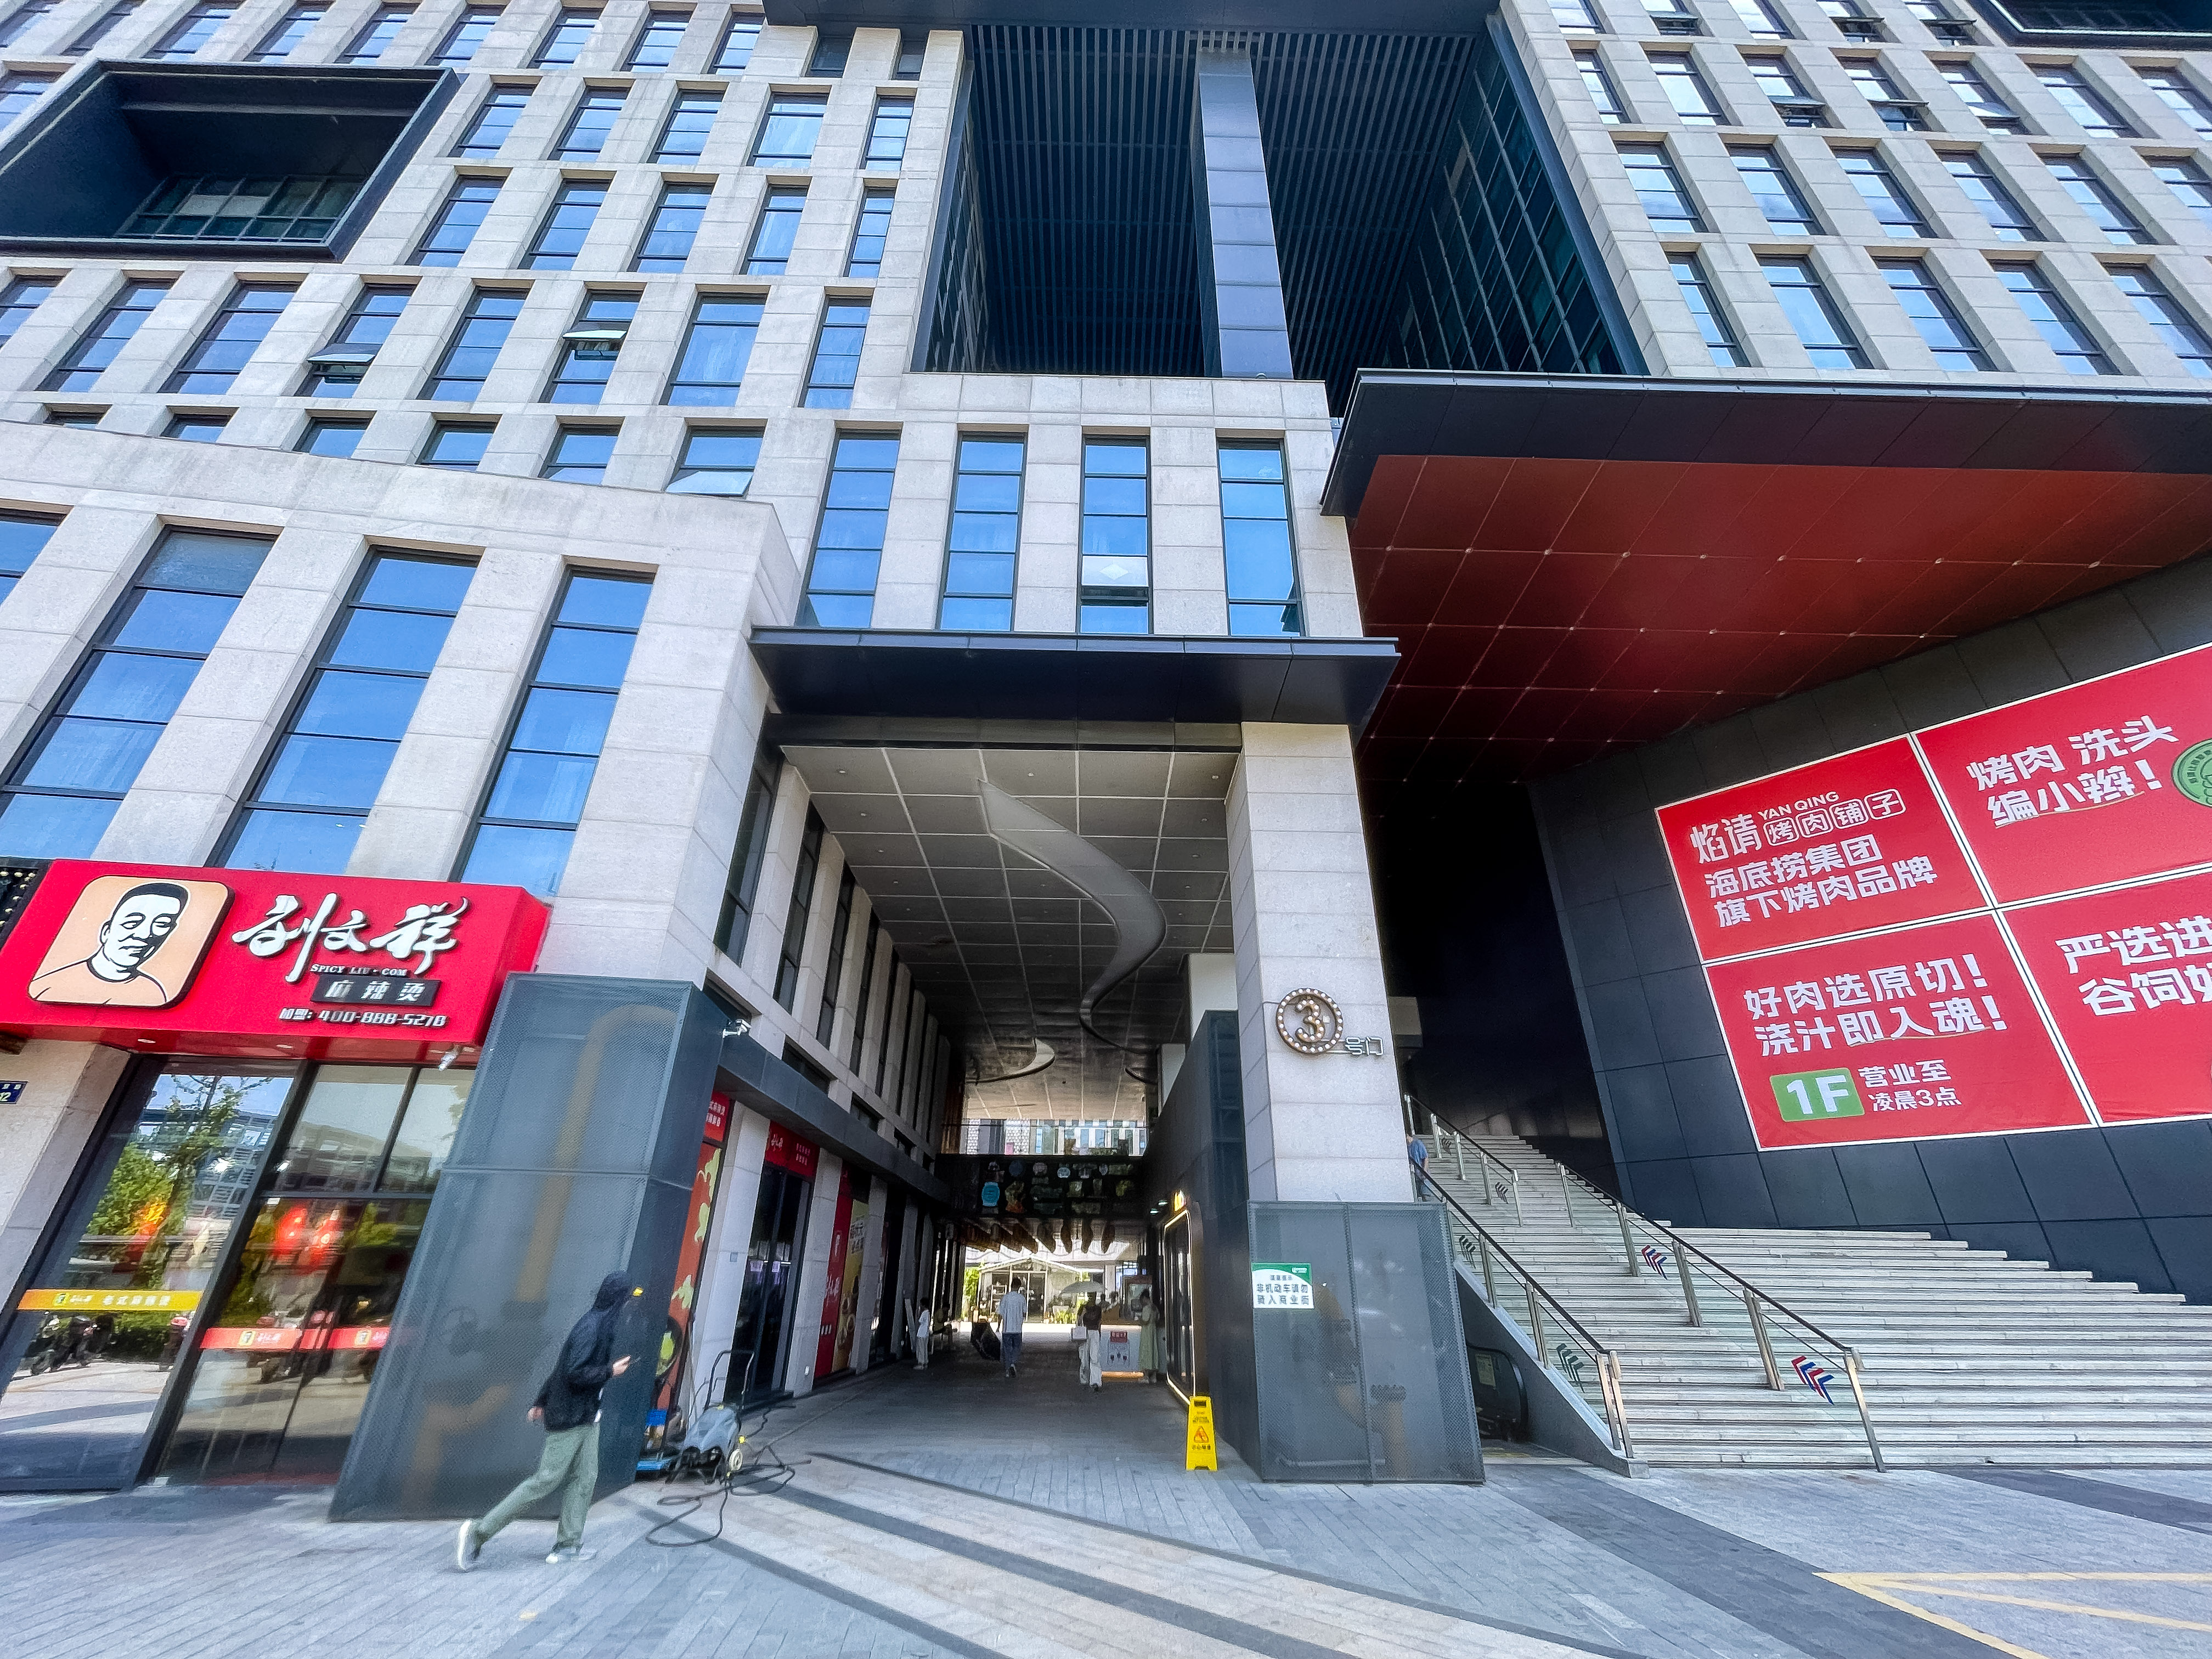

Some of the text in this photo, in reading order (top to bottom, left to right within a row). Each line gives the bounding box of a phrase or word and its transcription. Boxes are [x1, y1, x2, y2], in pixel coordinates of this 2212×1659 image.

[1966, 715, 2179, 791] 烤肉 洗头
[1690, 792, 1901, 864] 焰请 烤肉铺子
[1757, 791, 1839, 821] YAN QING
[1704, 833, 1883, 899] 海底捞集团
[1714, 855, 1938, 928] 旗下烤肉品牌
[310, 963, 346, 974] SPICY
[1743, 953, 1989, 1020] 好肉选原切！
[1753, 995, 2008, 1057] 浇汁即入魂！
[1786, 1075, 1851, 1115] 1F
[1858, 1059, 1951, 1088] 营业至
[1867, 1086, 1962, 1112] 凌晨3点
